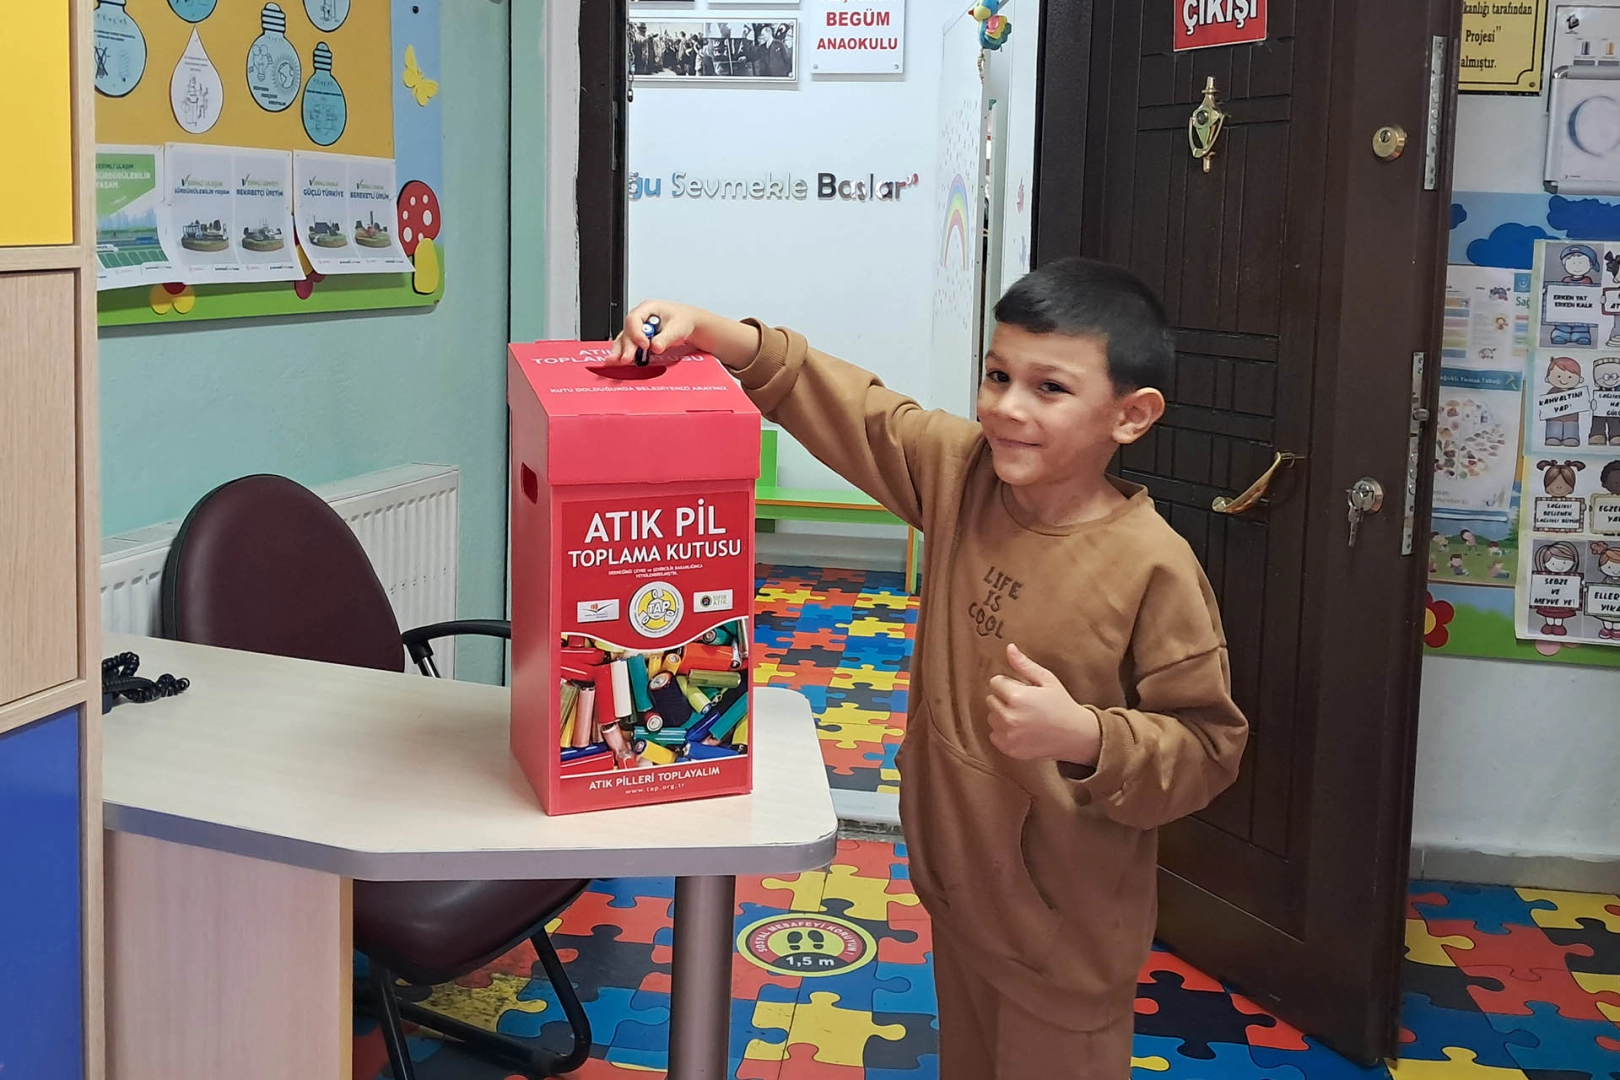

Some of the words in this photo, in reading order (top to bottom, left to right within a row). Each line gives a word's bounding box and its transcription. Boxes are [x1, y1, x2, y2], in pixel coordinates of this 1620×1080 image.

[1492, 2, 1532, 15] tarafından
[826, 8, 890, 26] BEGÜM
[817, 37, 898, 50] ANAOKULU
[303, 187, 321, 197] GÜÇLÜ
[322, 189, 344, 198] TÜRKİYE
[672, 172, 808, 200] Sevmekle
[531, 355, 607, 365] TOPLAM
[575, 385, 634, 393] DOLDUĞUNDA
[1539, 391, 1583, 406] KAHVALTINI
[583, 508, 664, 544] ATIK
[675, 498, 727, 537] PİL
[568, 544, 662, 568] TOPLAMA
[667, 539, 741, 561] KUTUSU
[983, 566, 1024, 600] LIFE
[648, 601, 671, 614] TAP
[983, 590, 1002, 612] IS
[1534, 597, 1560, 606] MEYVE
[968, 601, 1004, 639] COOL
[589, 779, 613, 790] ATIK
[616, 772, 655, 786] PİLLERİ
[658, 766, 720, 782] TOPLAYALIM
[754, 931, 771, 953] SOSYAL
[767, 921, 825, 932] MESAFEYİ
[786, 956, 812, 967] 1,5
[819, 958, 835, 966] m
